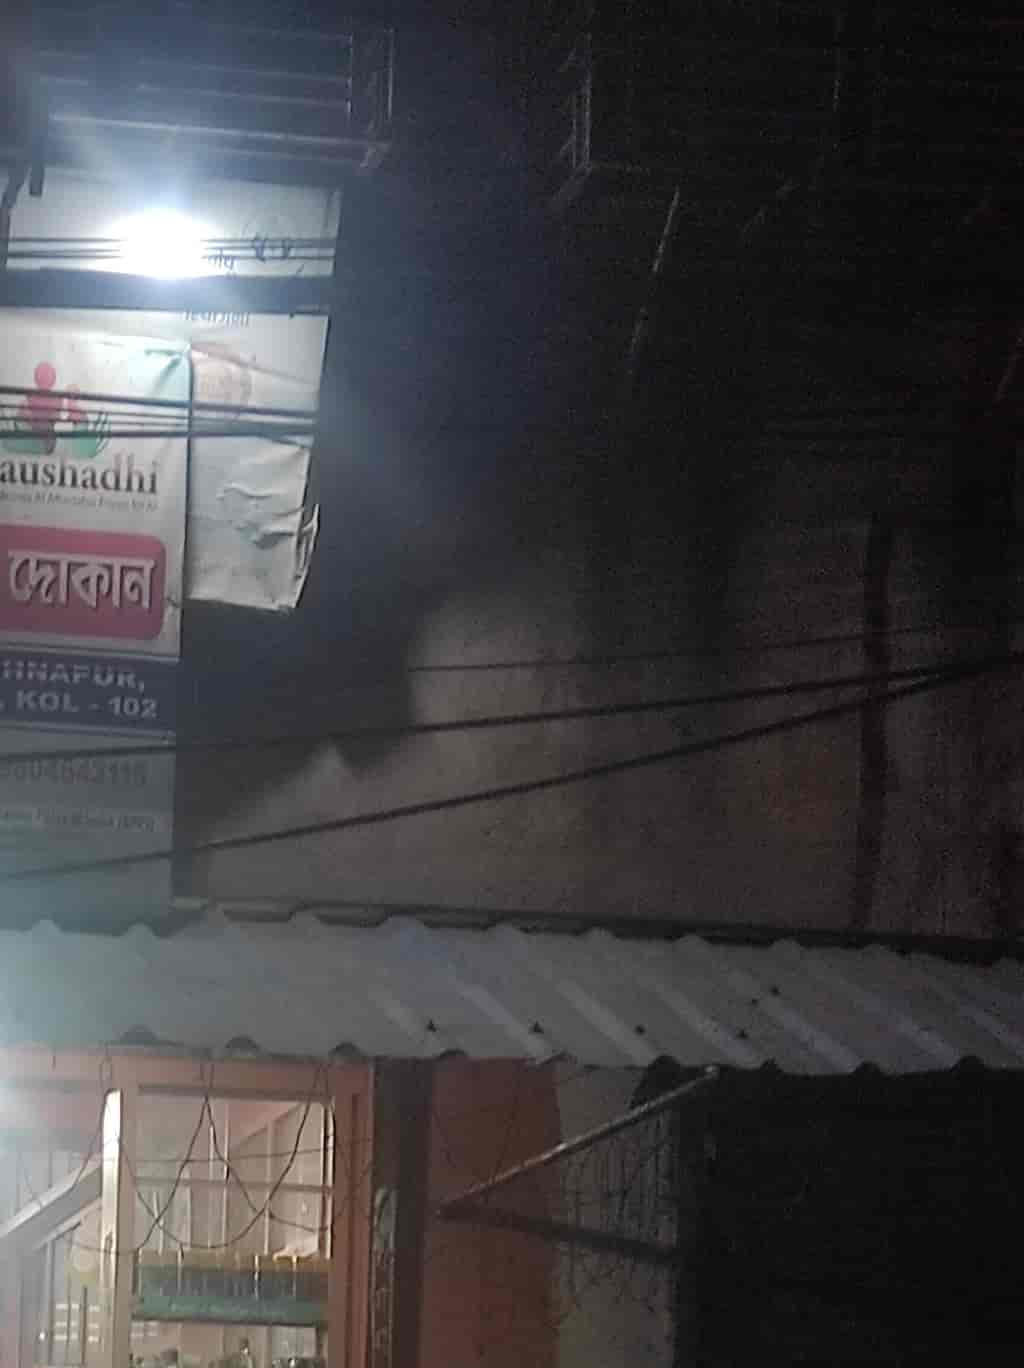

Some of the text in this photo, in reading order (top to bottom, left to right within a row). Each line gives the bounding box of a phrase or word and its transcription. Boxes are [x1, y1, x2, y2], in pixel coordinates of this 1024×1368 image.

[0, 450, 158, 495] aushadhi
[9, 547, 157, 609] দোকান
[109, 696, 158, 718] 102
